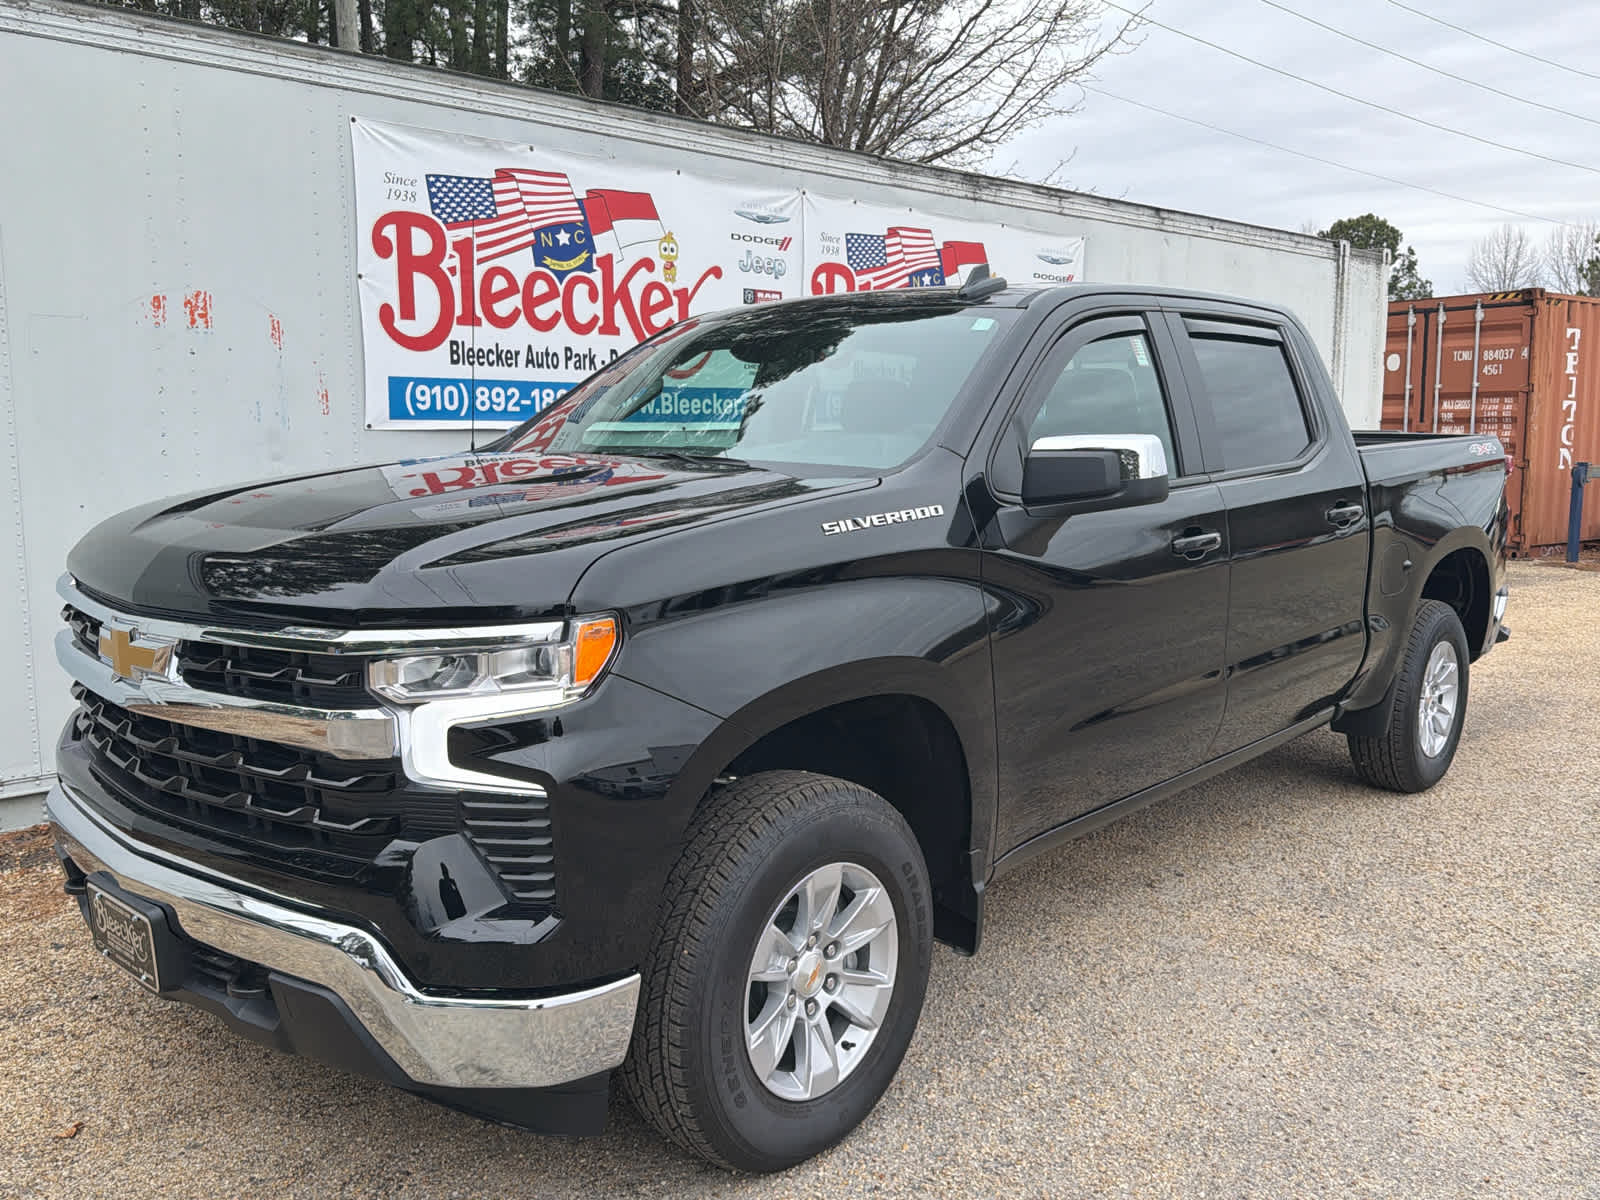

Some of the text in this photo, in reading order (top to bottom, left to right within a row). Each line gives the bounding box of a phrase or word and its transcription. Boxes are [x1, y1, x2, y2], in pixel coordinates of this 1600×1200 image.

[384, 171, 417, 187] Since
[385, 188, 417, 203] 1938
[541, 232, 552, 247] N
[731, 233, 783, 246] DODGE
[820, 231, 841, 245] Since
[821, 245, 840, 257] 1938
[739, 249, 786, 279] Jeep
[450, 340, 520, 368] Bleecker
[525, 344, 559, 369] Auto
[564, 346, 597, 371] Park
[1453, 350, 1473, 361] TCNU
[1483, 348, 1515, 361] 884037
[405, 381, 469, 416] (910)
[822, 504, 945, 536] SILVERADO
